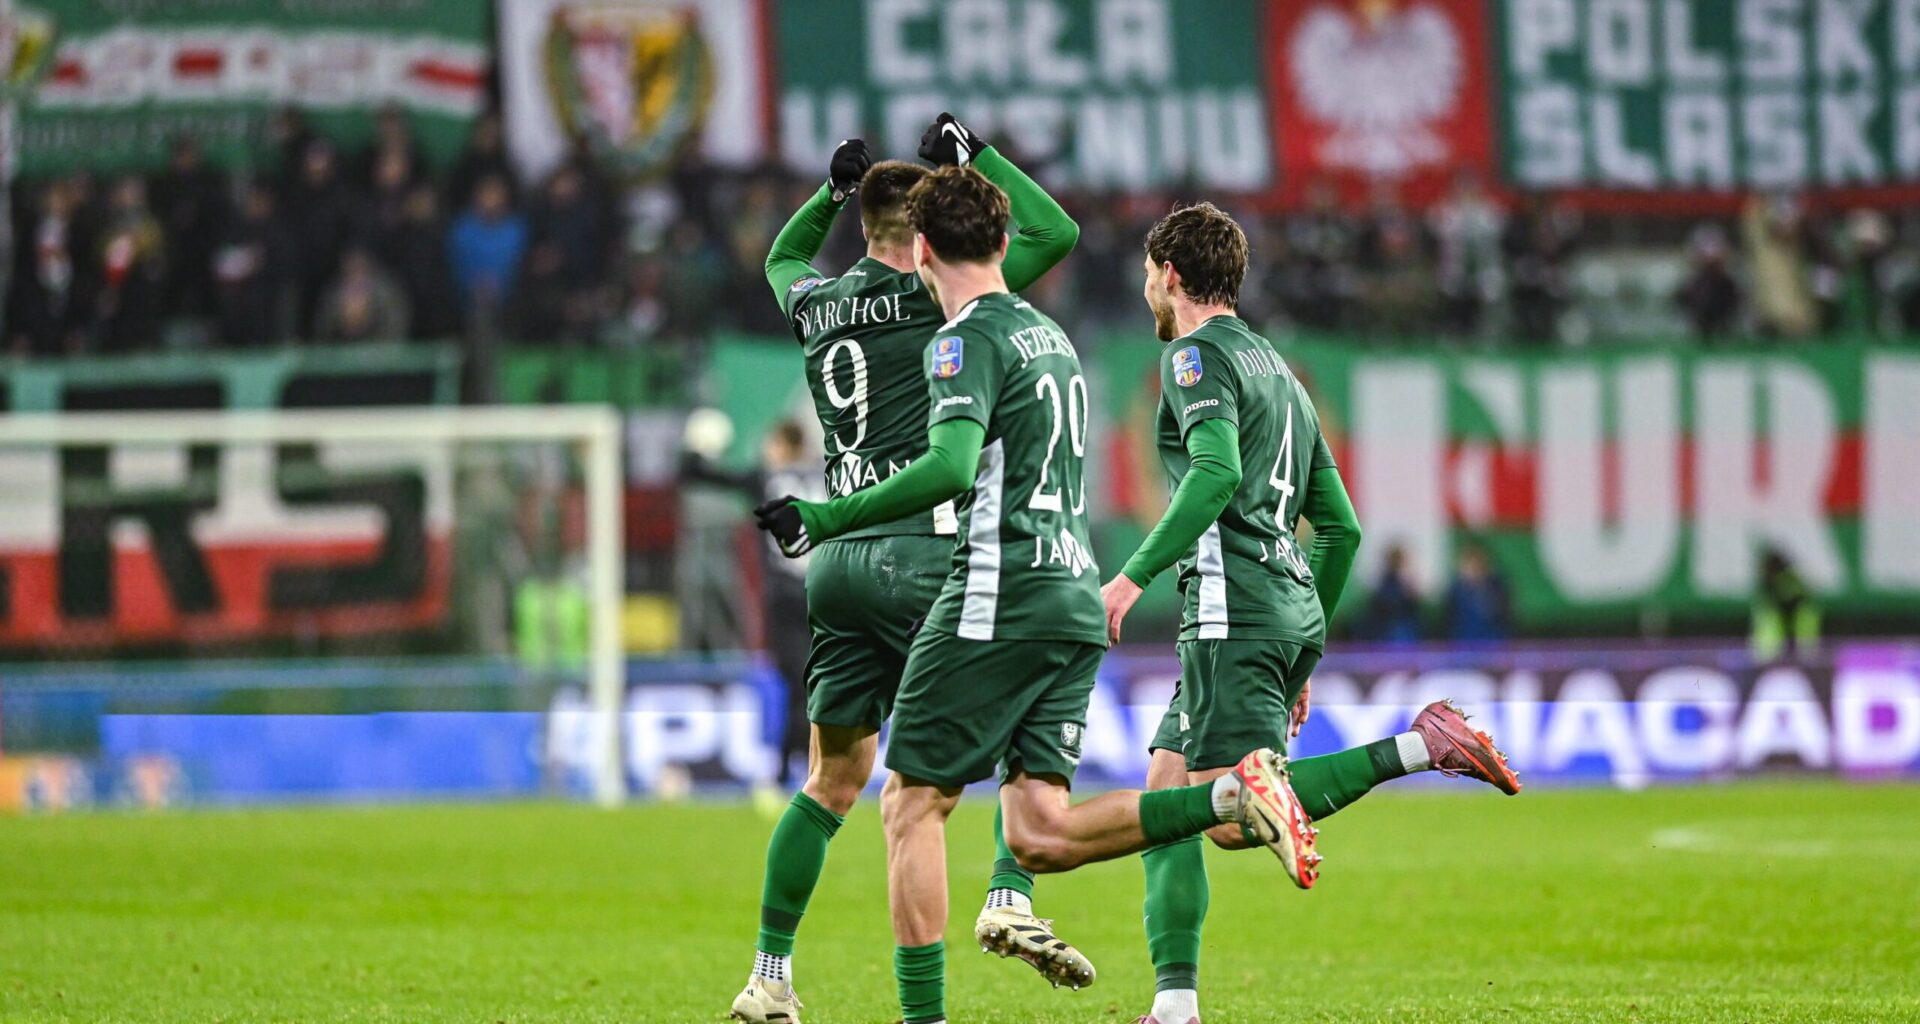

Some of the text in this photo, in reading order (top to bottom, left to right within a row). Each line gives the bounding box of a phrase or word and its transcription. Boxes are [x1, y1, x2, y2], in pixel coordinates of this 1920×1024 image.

[795, 293, 911, 339] WARCHOŁ
[822, 338, 868, 453] 9
[1269, 401, 1296, 532] 4
